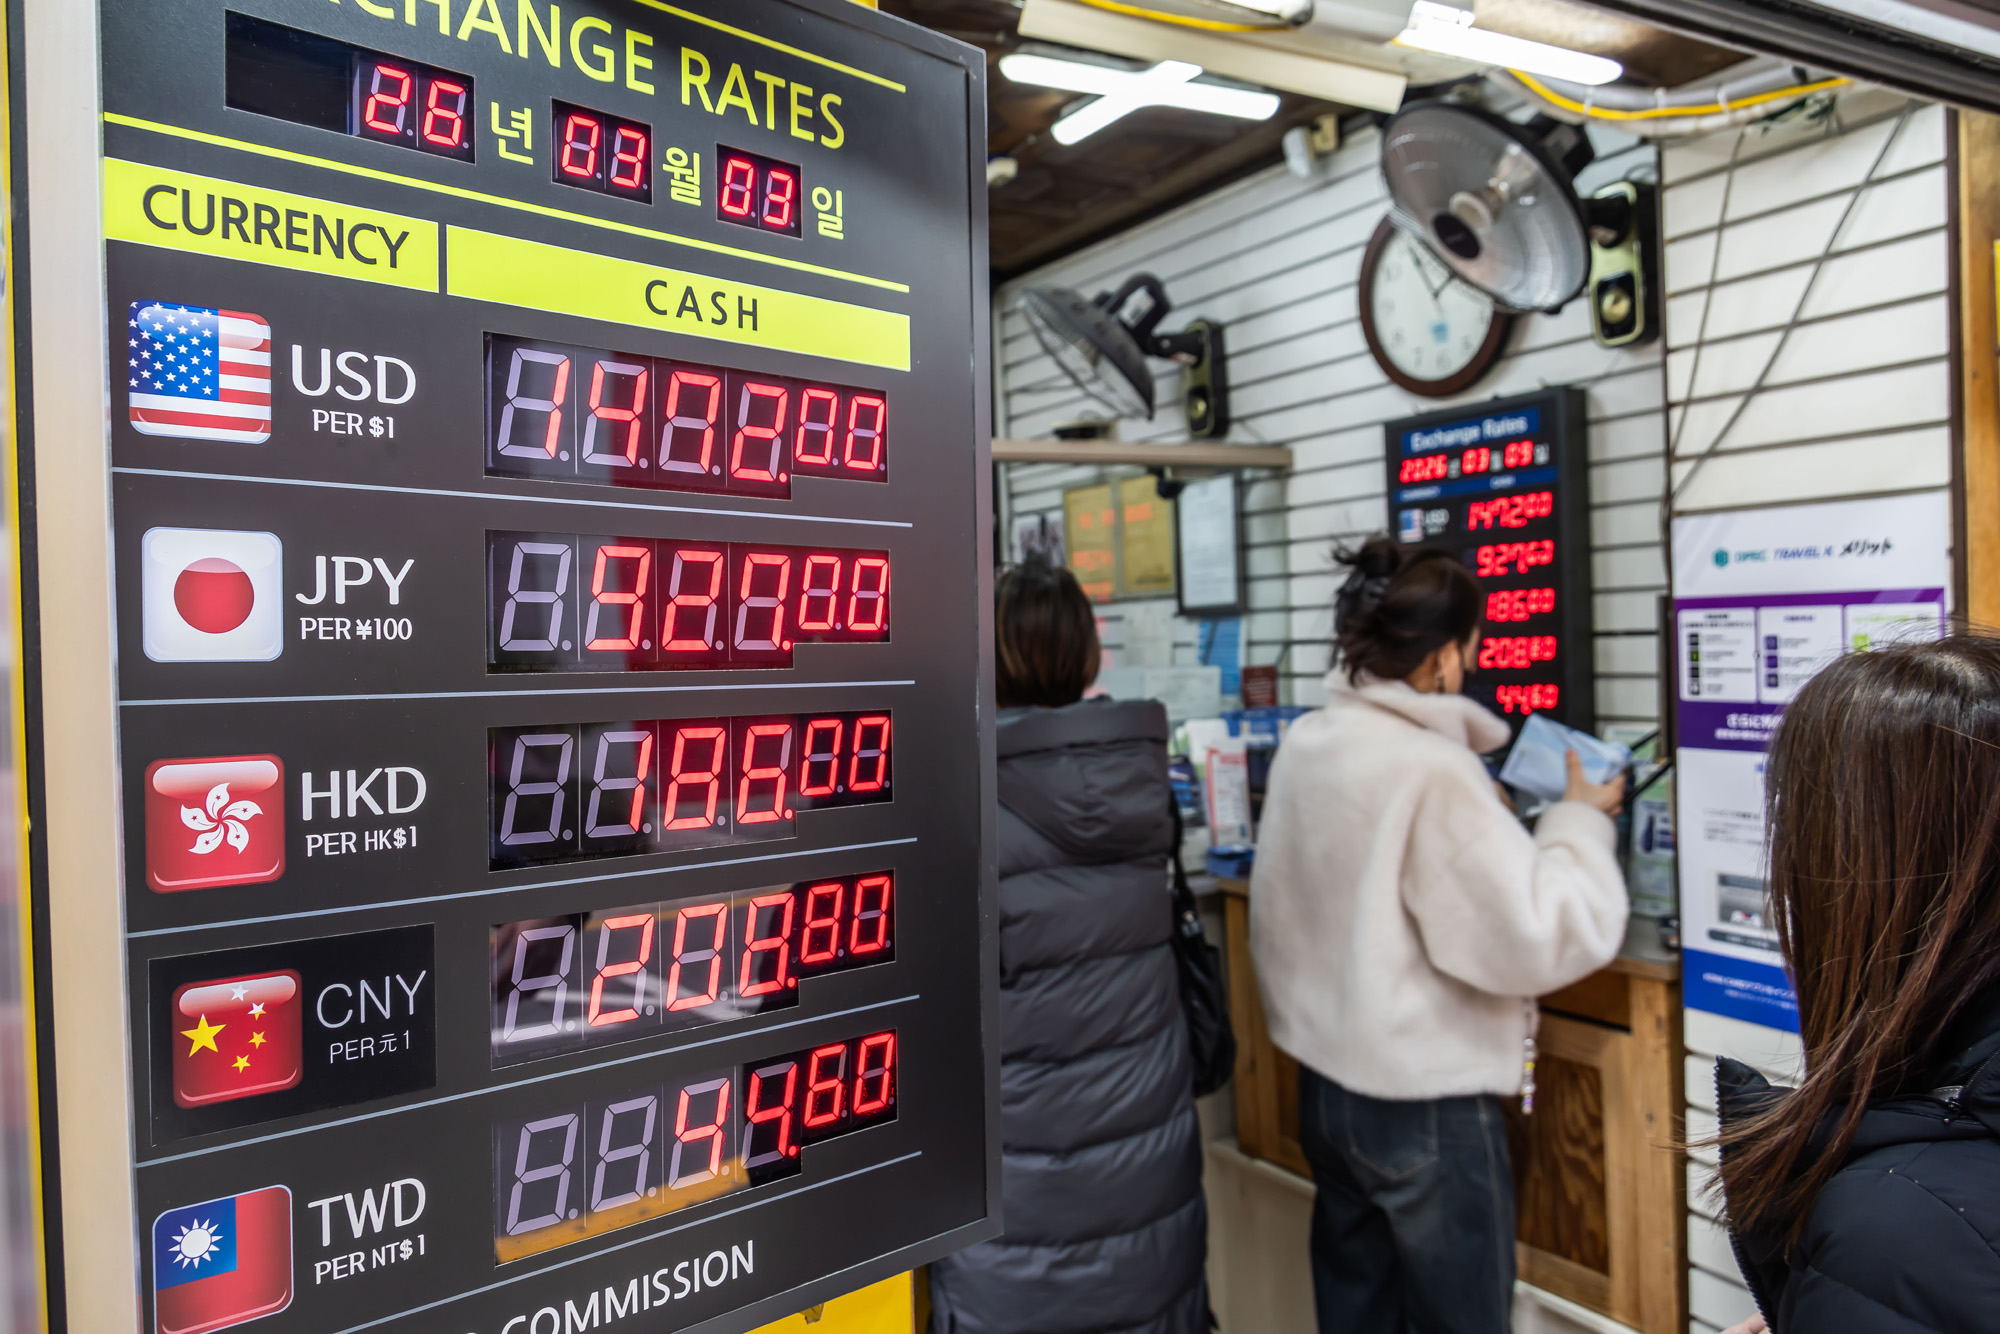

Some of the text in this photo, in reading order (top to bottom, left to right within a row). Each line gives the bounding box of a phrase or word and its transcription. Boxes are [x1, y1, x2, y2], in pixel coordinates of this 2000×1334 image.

[681, 46, 845, 150] RATES
[365, 64, 845, 241] 26 년 03 월 03 일
[142, 184, 410, 269] CURRENCY
[644, 280, 759, 332] CASH
[292, 344, 417, 405] USD
[312, 409, 395, 438] PER $1
[1411, 416, 1528, 452] Exchange Rates
[1399, 454, 1448, 483] 2026
[296, 555, 415, 606] JPY
[300, 617, 352, 640] PER
[301, 766, 428, 821] HKD
[305, 826, 418, 857] PER HK$1
[316, 970, 427, 1029] CNY
[307, 1178, 427, 1247] TWD
[314, 1251, 366, 1285] PER
